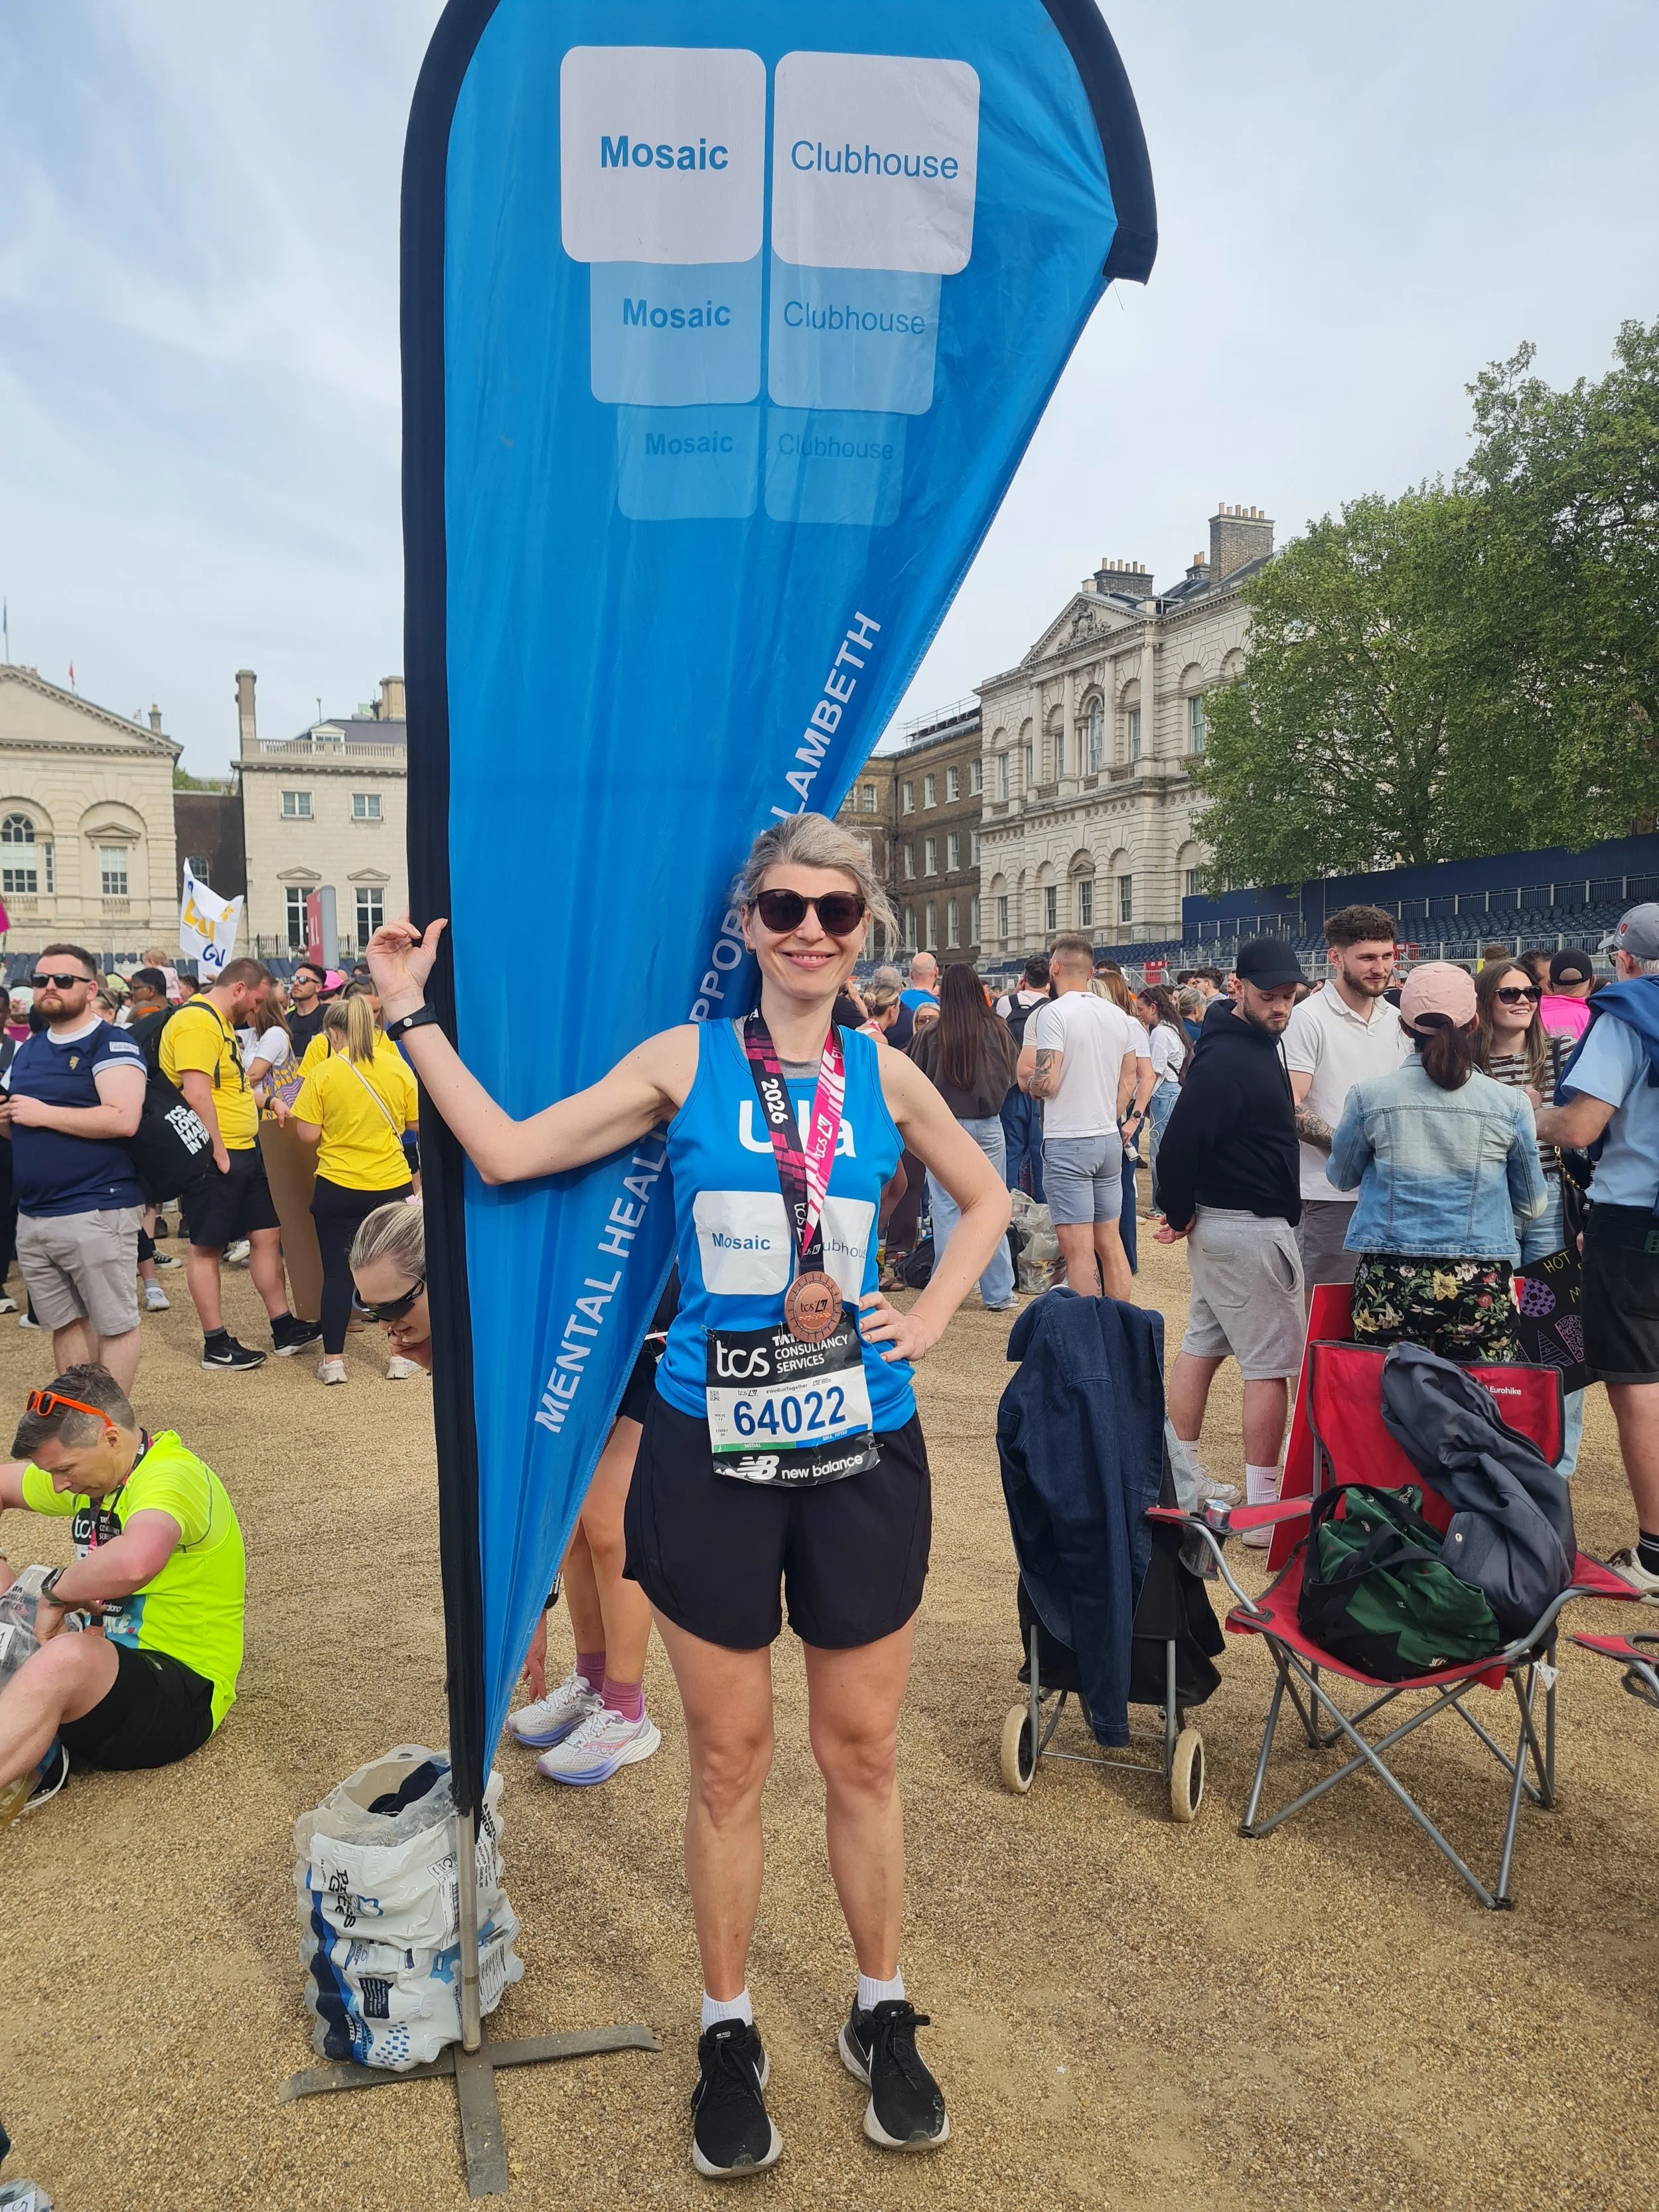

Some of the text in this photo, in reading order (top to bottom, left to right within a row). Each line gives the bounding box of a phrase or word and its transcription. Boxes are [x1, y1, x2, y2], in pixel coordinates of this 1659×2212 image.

[600, 135, 959, 180] Mosaic Clubhouse
[622, 298, 926, 335] Mosaic Clubhouse
[645, 430, 894, 461] Mosaic Clubhouse
[534, 1270, 622, 1434] MENTAL
[597, 1131, 667, 1258] HEALT
[770, 611, 881, 818] LAMBETH
[761, 1078, 788, 1124] 2026
[164, 1105, 187, 1124] TCS
[173, 1109, 200, 1136] LOND
[186, 1138, 202, 1155] IN
[812, 1136, 828, 1158] tcs
[712, 1232, 771, 1250] Mosaic
[1543, 1250, 1571, 1274] HOT
[800, 1303, 814, 1313] tcs
[772, 1333, 800, 1347] TAT
[774, 1334, 849, 1361] CONSULTANCY
[716, 1339, 770, 1378] tcs
[776, 1353, 825, 1374] SERVICES
[766, 1383, 808, 1394] #WeRunTogether
[1489, 1385, 1522, 1396] Eurohike
[733, 1386, 846, 1437] 64022
[781, 1453, 863, 1479] new balance
[74, 1514, 92, 1539] tc
[483, 1803, 489, 1812] A
[478, 1845, 486, 1865] source
[344, 2014, 356, 2041] WATER
